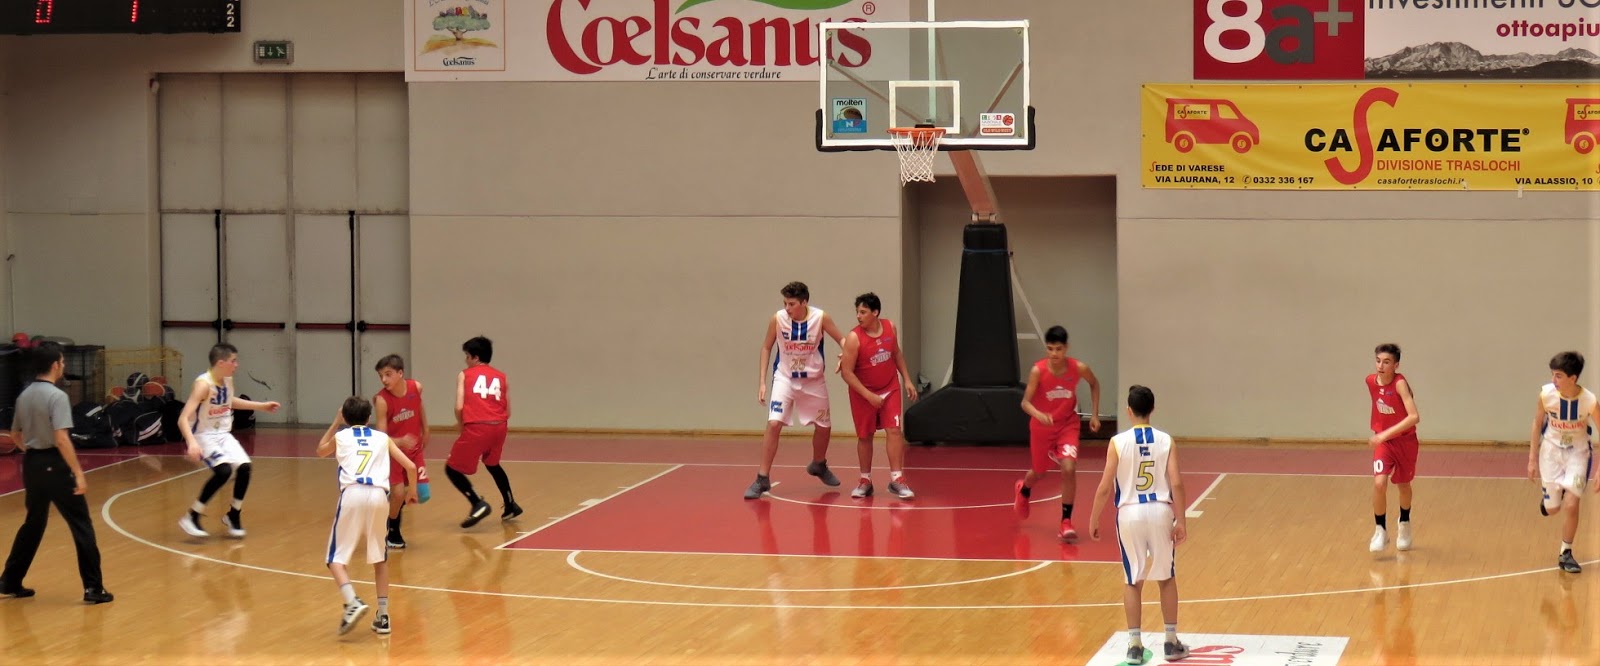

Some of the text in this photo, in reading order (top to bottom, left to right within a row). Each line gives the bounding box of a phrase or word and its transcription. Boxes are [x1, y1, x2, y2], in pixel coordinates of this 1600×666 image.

[1496, 17, 1600, 41] ottoapiu
[679, 68, 688, 79] di
[690, 71, 741, 79] conservare
[744, 68, 781, 79] verdure
[1376, 160, 1520, 172] DIVISIONE TRASLOCHI
[1155, 176, 1172, 184] VIA
[1173, 176, 1221, 184] LAURANA,
[1515, 177, 1593, 186] VIA ALASSIO, 10
[472, 375, 502, 401] 44
[355, 450, 373, 475] 7
[1136, 460, 1155, 491] 5
